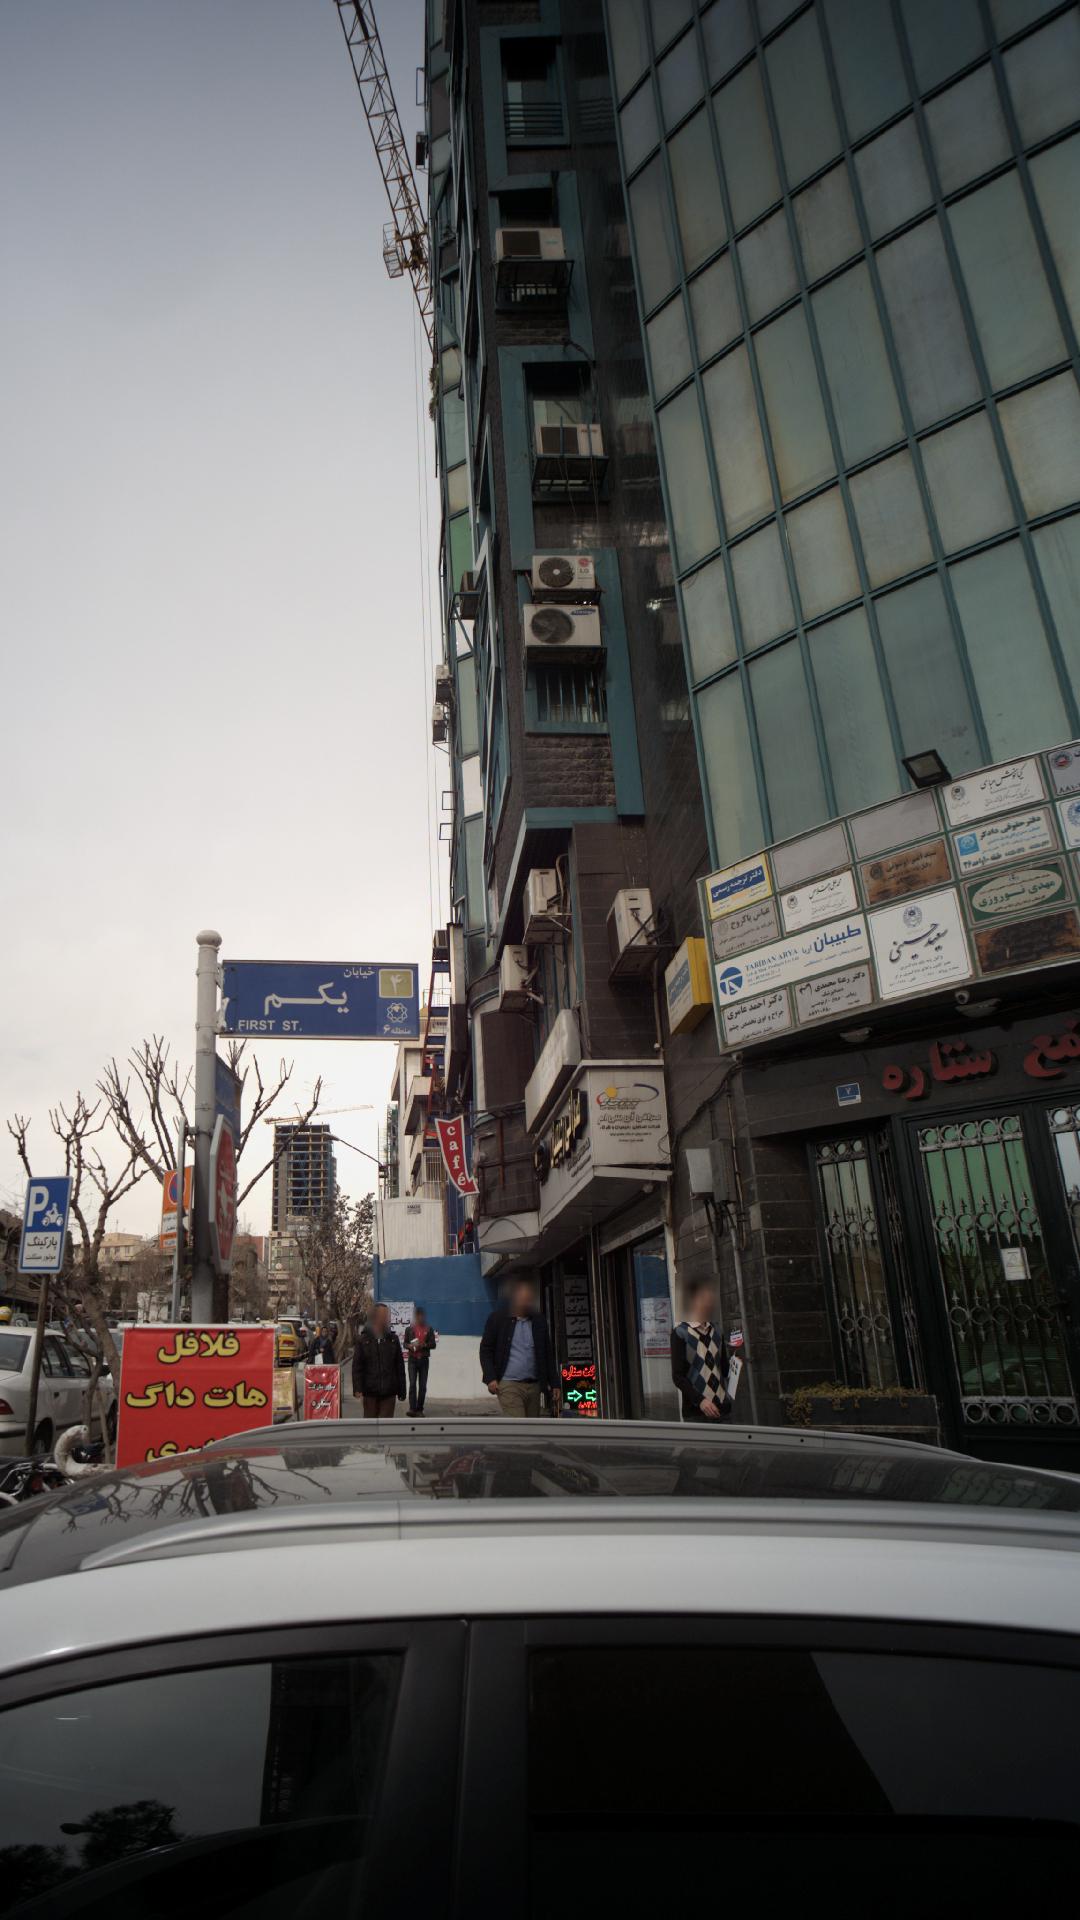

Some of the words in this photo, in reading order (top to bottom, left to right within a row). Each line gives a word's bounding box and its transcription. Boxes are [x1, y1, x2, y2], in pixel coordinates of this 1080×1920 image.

[730, 875, 748, 887] ترجمه
[749, 869, 762, 882] دفتر
[713, 886, 730, 898] رسمی
[1028, 880, 1056, 894] مهدی
[978, 885, 1026, 907] نوروزی
[813, 924, 861, 952] طبیبان
[889, 923, 939, 964] حسینی
[924, 928, 948, 952] سعید
[344, 966, 376, 979] خیابان
[852, 972, 865, 982] دکتر
[815, 982, 836, 992] محمدی
[264, 982, 350, 1016] یکم
[749, 998, 766, 1012] احمد
[768, 994, 783, 1008] دکتر
[728, 1006, 747, 1020] عامری
[238, 1020, 276, 1030] FIRST
[282, 1020, 302, 1032] ST.
[383, 1025, 390, 1035] ۶
[391, 1026, 412, 1035] منطقه
[882, 1040, 993, 1100] ستاره
[446, 1126, 466, 1187] café
[27, 1186, 49, 1227] P
[27, 1236, 58, 1250] پارکینگ
[158, 1329, 241, 1364] فلافل
[126, 1381, 196, 1408] داگ
[202, 1381, 268, 1408] هات
[311, 1398, 332, 1410] ستاره
